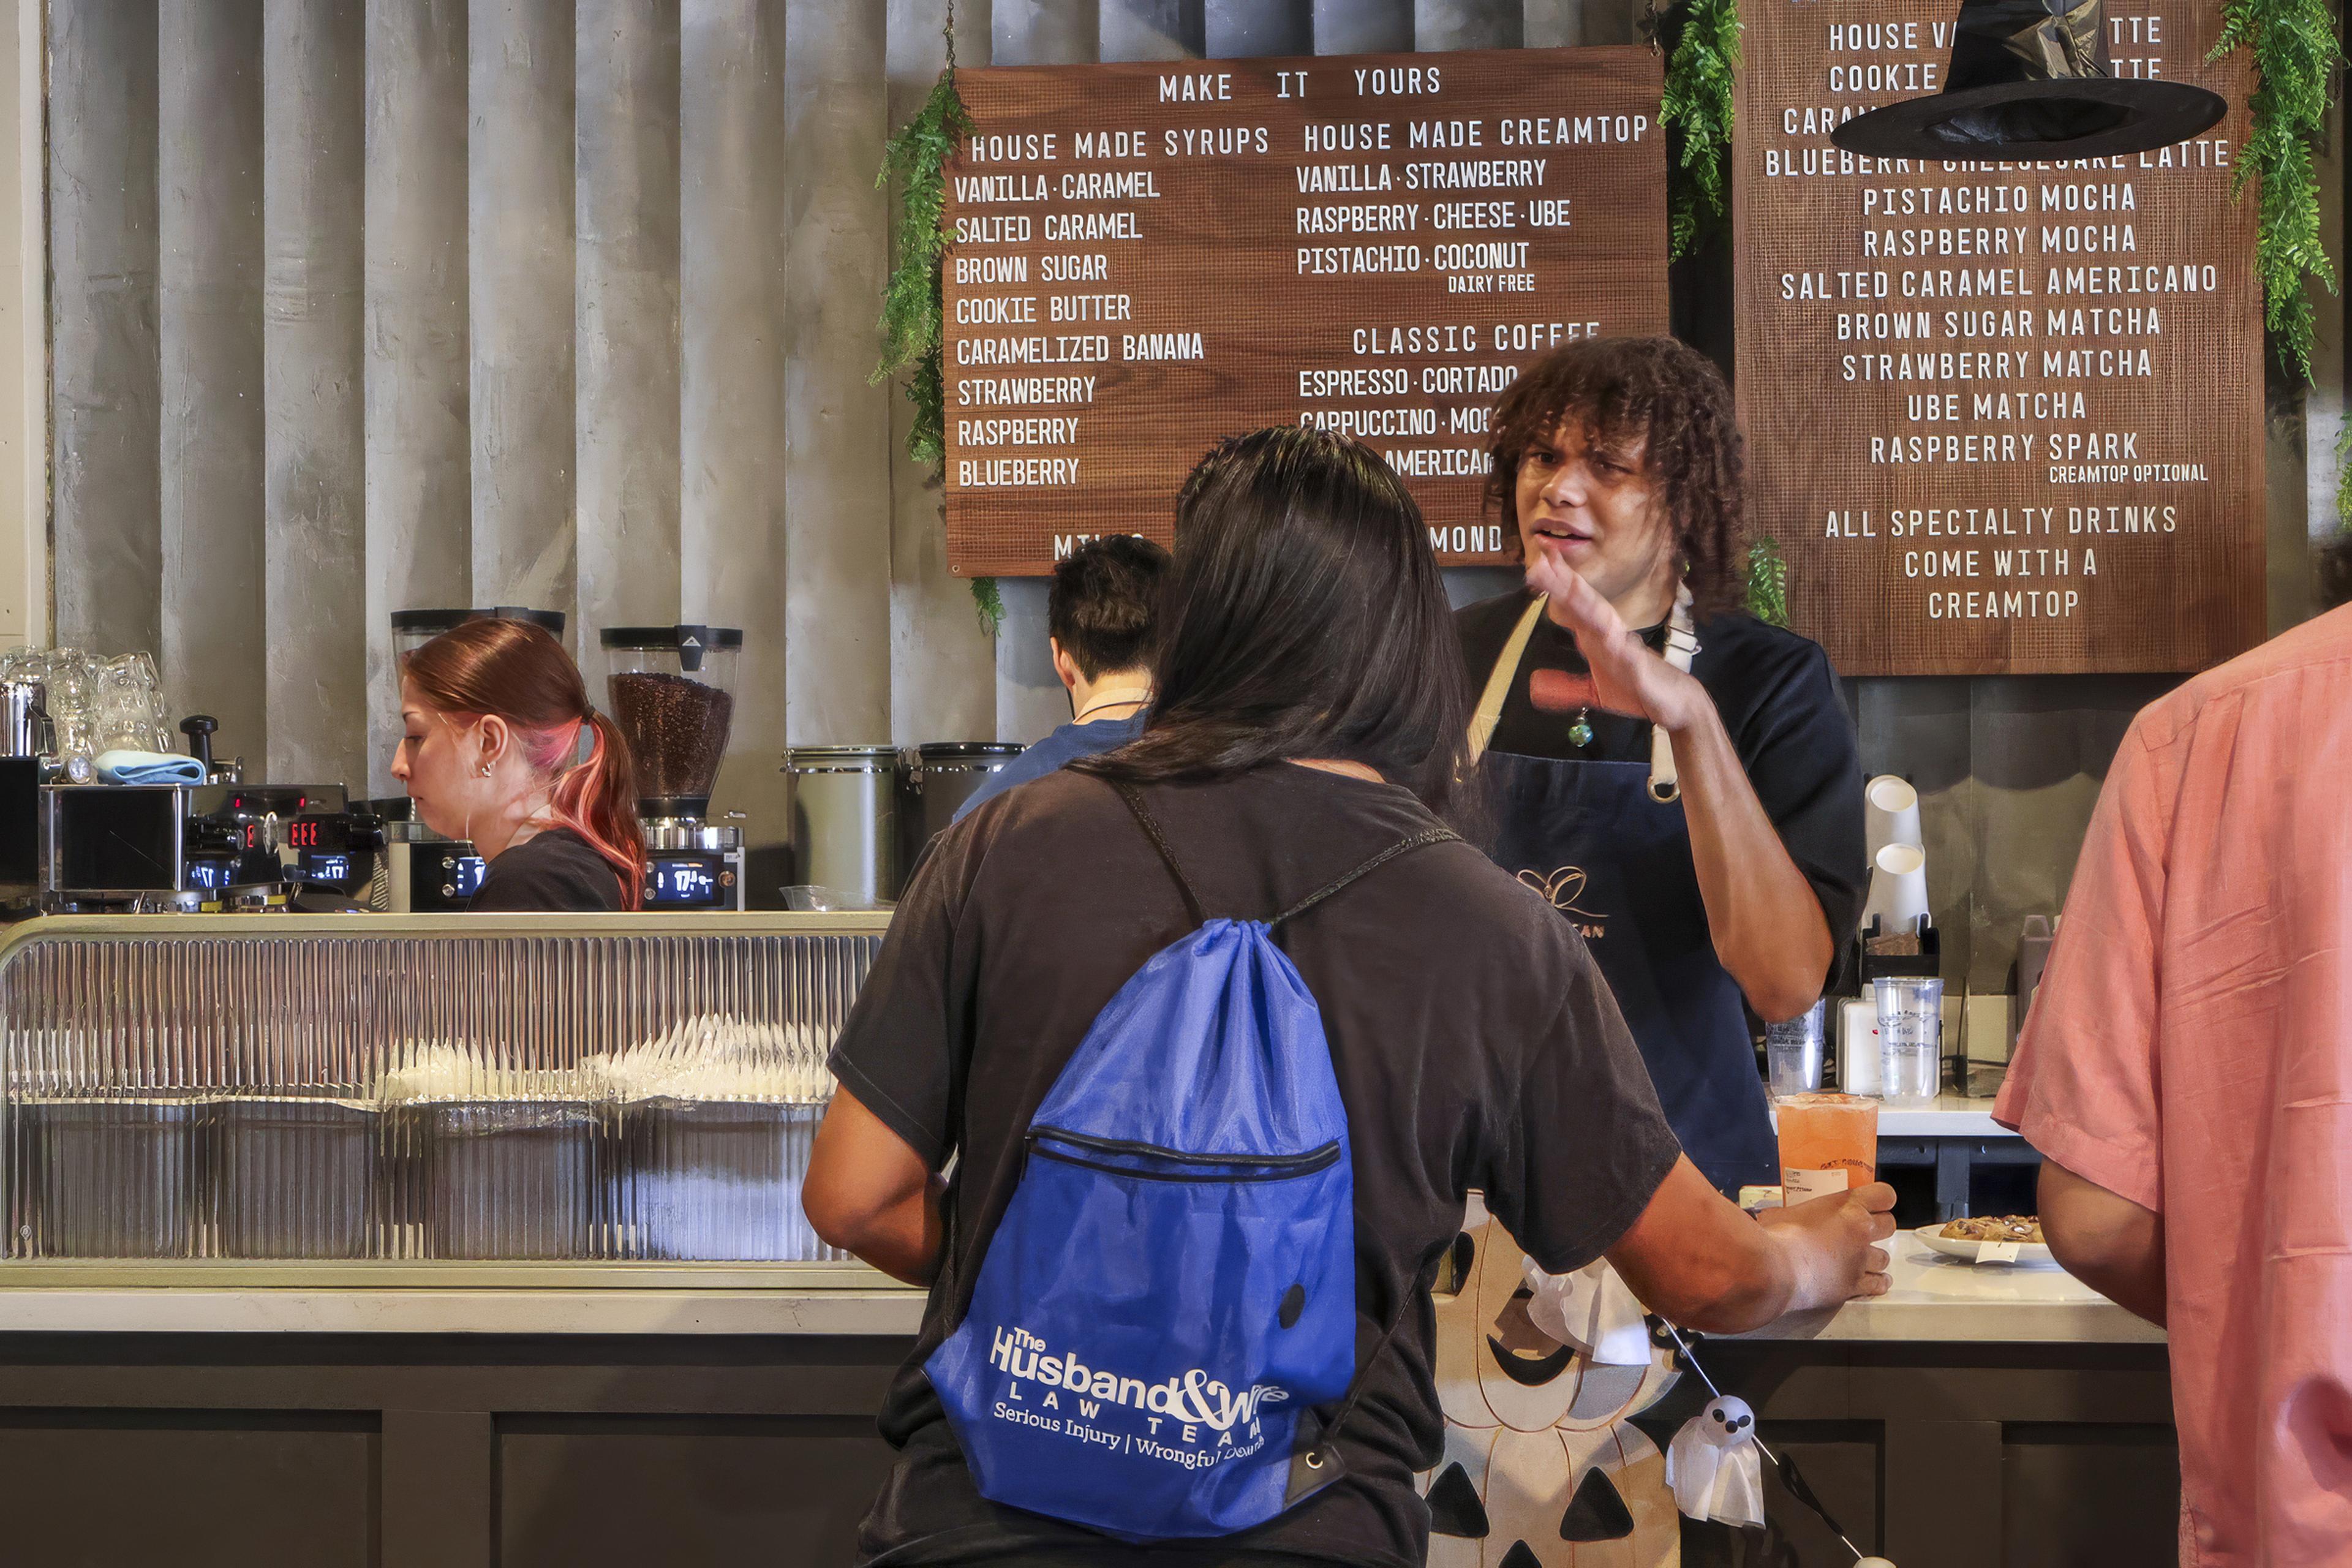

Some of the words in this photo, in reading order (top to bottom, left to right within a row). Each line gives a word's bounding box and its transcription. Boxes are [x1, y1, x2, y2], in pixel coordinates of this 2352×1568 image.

[1830, 22, 1918, 51] HOUSE
[1159, 74, 1232, 102] MAKE
[1276, 71, 1308, 98] IT
[1354, 67, 1440, 96] YOURS
[1830, 63, 1937, 92] COOKIE
[972, 134, 1057, 162] HOUSE
[1075, 131, 1147, 159] MADE
[1165, 127, 1268, 156] SYRUPS
[1305, 123, 1391, 152] HOUSE
[1409, 120, 1482, 149] MADE
[1501, 115, 1647, 146] CREAMTOP
[2139, 140, 2228, 168] LATTE
[1864, 186, 2027, 216] PISTACHIO
[2041, 183, 2135, 212] MOCHA
[956, 216, 1031, 243] SALTED
[1045, 212, 1143, 241] CARAMEL
[1864, 226, 2027, 257] RASPBERRY
[2042, 224, 2136, 254] MOCHA
[956, 256, 1027, 284] BROWN
[1041, 254, 1108, 282] SUGAR
[1448, 274, 1493, 293] DAIRY
[1498, 273, 1535, 292] FREE
[1781, 271, 1888, 300] SALTED
[1902, 268, 2033, 297] CARAMEL
[2047, 265, 2216, 295] AMERICANO
[956, 296, 1037, 324] COOKIE
[1050, 294, 1131, 322] BUTTER
[1838, 311, 1931, 340] BROWN
[1945, 309, 2033, 338] SUGAR
[2048, 305, 2160, 336] MATCHA
[957, 335, 1109, 365] CARAMELIZED
[1123, 333, 1204, 361] BANANA
[1353, 325, 1476, 355] CLASSIC
[1842, 350, 2029, 382] STRAWBERRY
[2043, 348, 2152, 378] MATCHA
[958, 375, 1096, 405] STRAWBERRY
[1450, 407, 1492, 434] MOC
[1908, 394, 1959, 421] UBE
[1973, 391, 2086, 421] MATCHA
[958, 417, 1079, 446] RASPBERRY
[1871, 434, 2034, 464] RASPBERRY
[2049, 432, 2138, 461] SPARK
[959, 458, 1079, 486] BLUEBERRY
[2049, 465, 2128, 484] CREAMTOP
[2133, 464, 2209, 483] OPTIONAL
[1825, 510, 1876, 538] ALL
[1891, 507, 2053, 537] SPECIALTY
[2068, 506, 2176, 533] DRINKS
[1430, 526, 1502, 552] MOND
[1905, 550, 1980, 578] COME
[1994, 548, 2068, 576] WITH
[2083, 548, 2097, 575] A
[1929, 590, 2078, 619] CREAMTOP
[1014, 1325, 1046, 1352] The
[1010, 1384, 1101, 1419] LAW
[993, 1402, 1060, 1433] Serious
[1065, 1419, 1121, 1450] Injury
[1136, 1438, 1221, 1471] Wrongful
